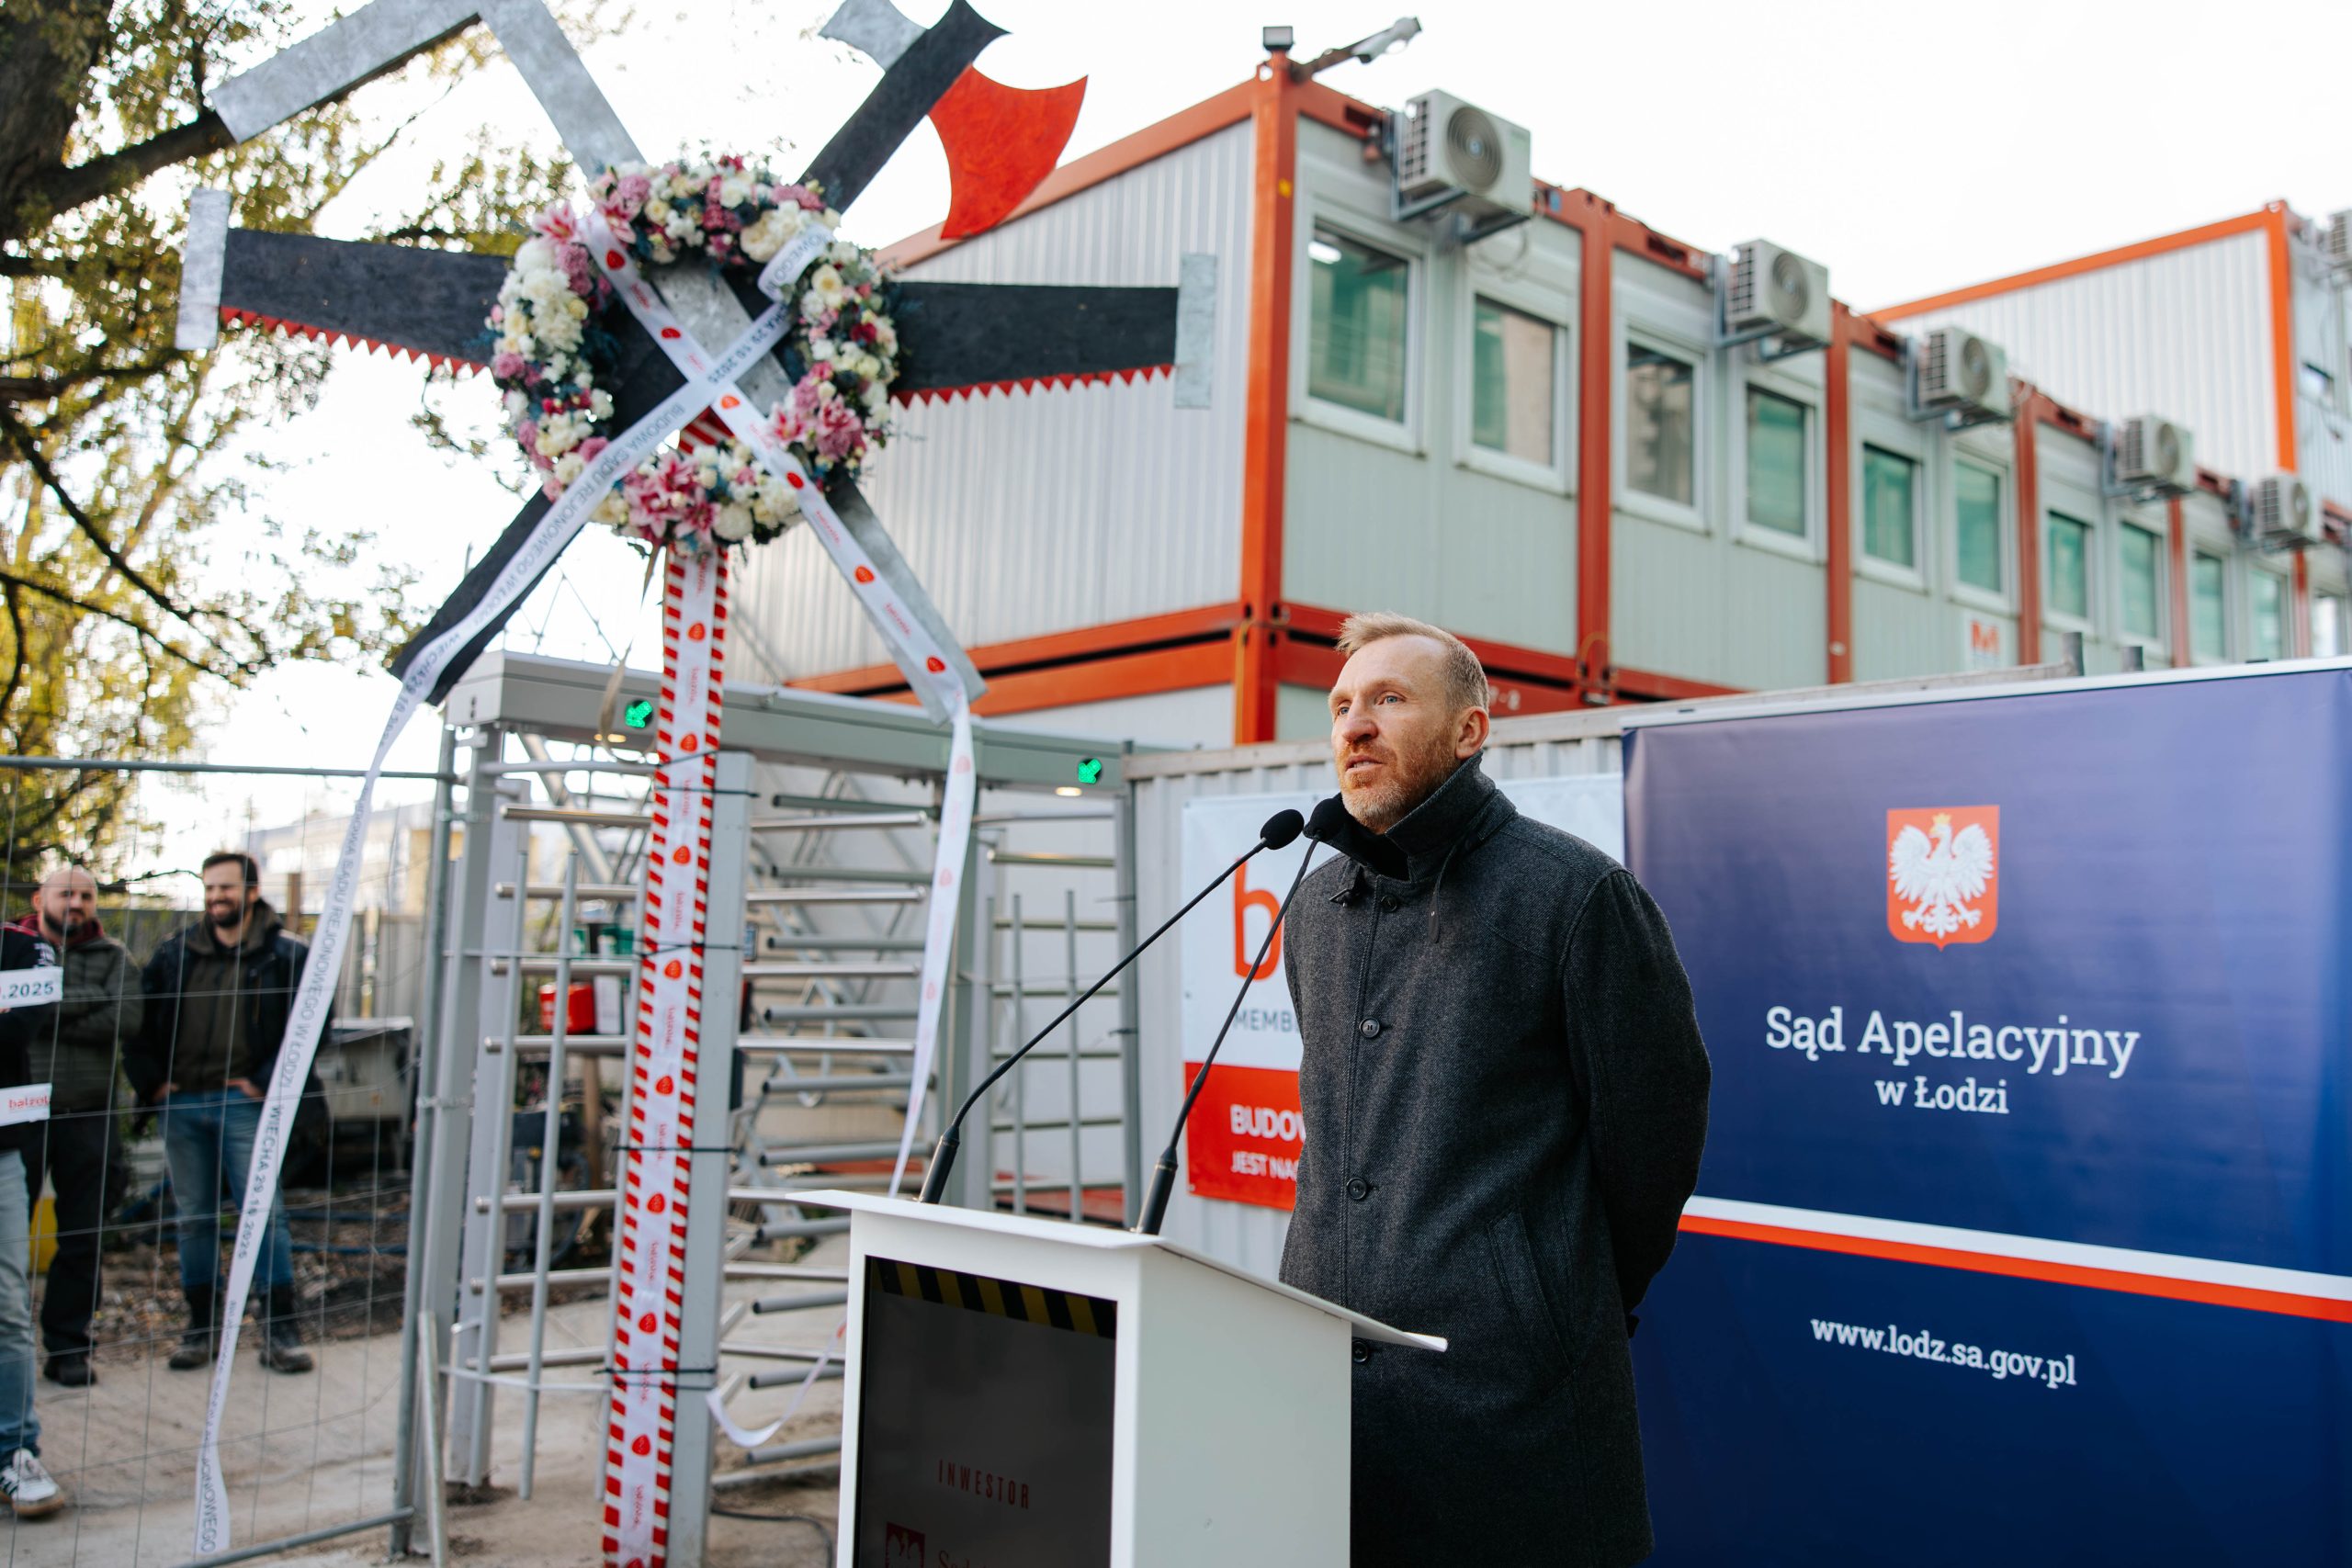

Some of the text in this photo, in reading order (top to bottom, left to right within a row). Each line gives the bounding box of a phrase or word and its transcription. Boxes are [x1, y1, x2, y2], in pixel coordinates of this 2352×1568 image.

[515, 484, 597, 575] REJONOWEGO
[300, 908, 345, 1021] REJONOWEGO
[1232, 1009, 1300, 1033] MEMB
[1766, 1006, 2141, 1079] Sąd Apelacyjny
[1874, 1076, 2010, 1114] w Łodzi
[255, 1105, 283, 1172] WIECHA
[1231, 1150, 1268, 1177] JEST
[1810, 1318, 2077, 1389] www.lodz.sa.gov.pl
[938, 1459, 1030, 1509] INWESTOR
